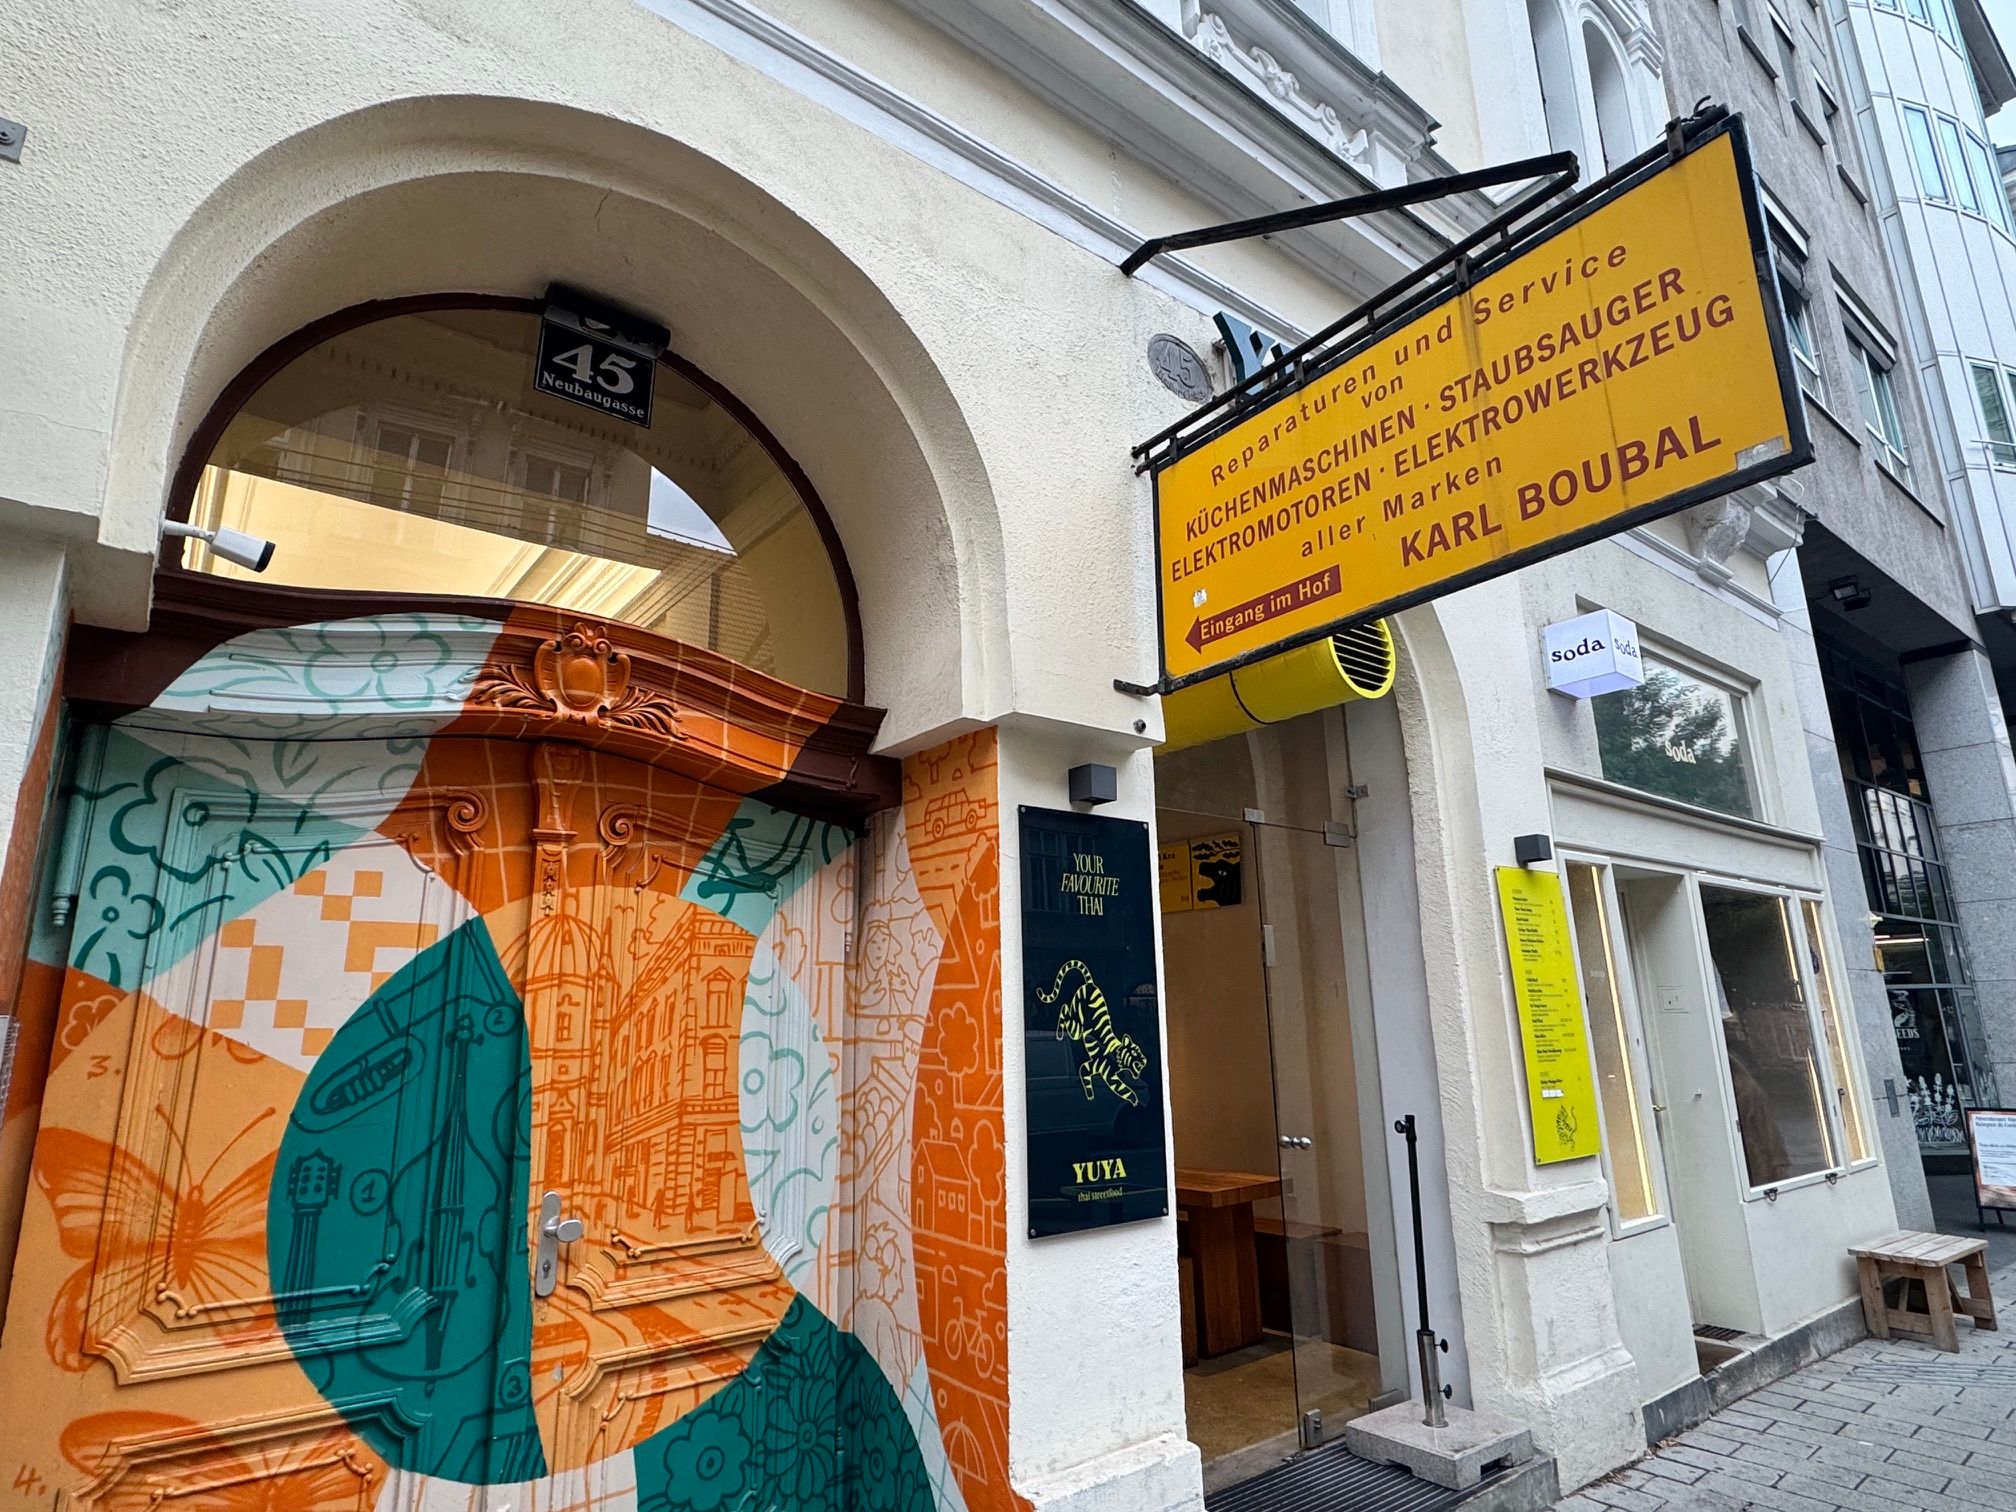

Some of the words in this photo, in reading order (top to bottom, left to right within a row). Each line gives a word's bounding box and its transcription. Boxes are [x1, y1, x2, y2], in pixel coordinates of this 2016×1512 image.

[552, 344, 637, 395] 45
[1211, 364, 1376, 488] Reparaturen
[1394, 314, 1453, 366] und
[1472, 245, 1627, 326] Service
[542, 371, 645, 418] Neubaugasse
[1186, 404, 1415, 542] KÜCHENMASCHINEN
[1439, 267, 1686, 412] STAUBSAUGER
[1360, 375, 1403, 409] von
[1171, 467, 1371, 583] ELEKTROMOTOREN
[1394, 294, 1735, 478] ELEKTROWERKZEUG
[1301, 515, 1366, 558] aller
[1382, 456, 1502, 522] Marken
[1400, 502, 1503, 568] KARL
[1517, 415, 1722, 522] BOUBAL
[1200, 603, 1264, 639] Eingang
[1270, 593, 1292, 612] im
[1298, 572, 1331, 600] Hof
[1552, 638, 1605, 662] soda
[1614, 637, 1638, 658] soda
[1665, 740, 1696, 764] soda
[1073, 853, 1104, 874] YOUR
[1061, 873, 1120, 896] FAVOURITE
[1077, 895, 1104, 916] THAI
[1895, 1028, 1920, 1039] EEDS
[1072, 1158, 1127, 1183] YUYA
